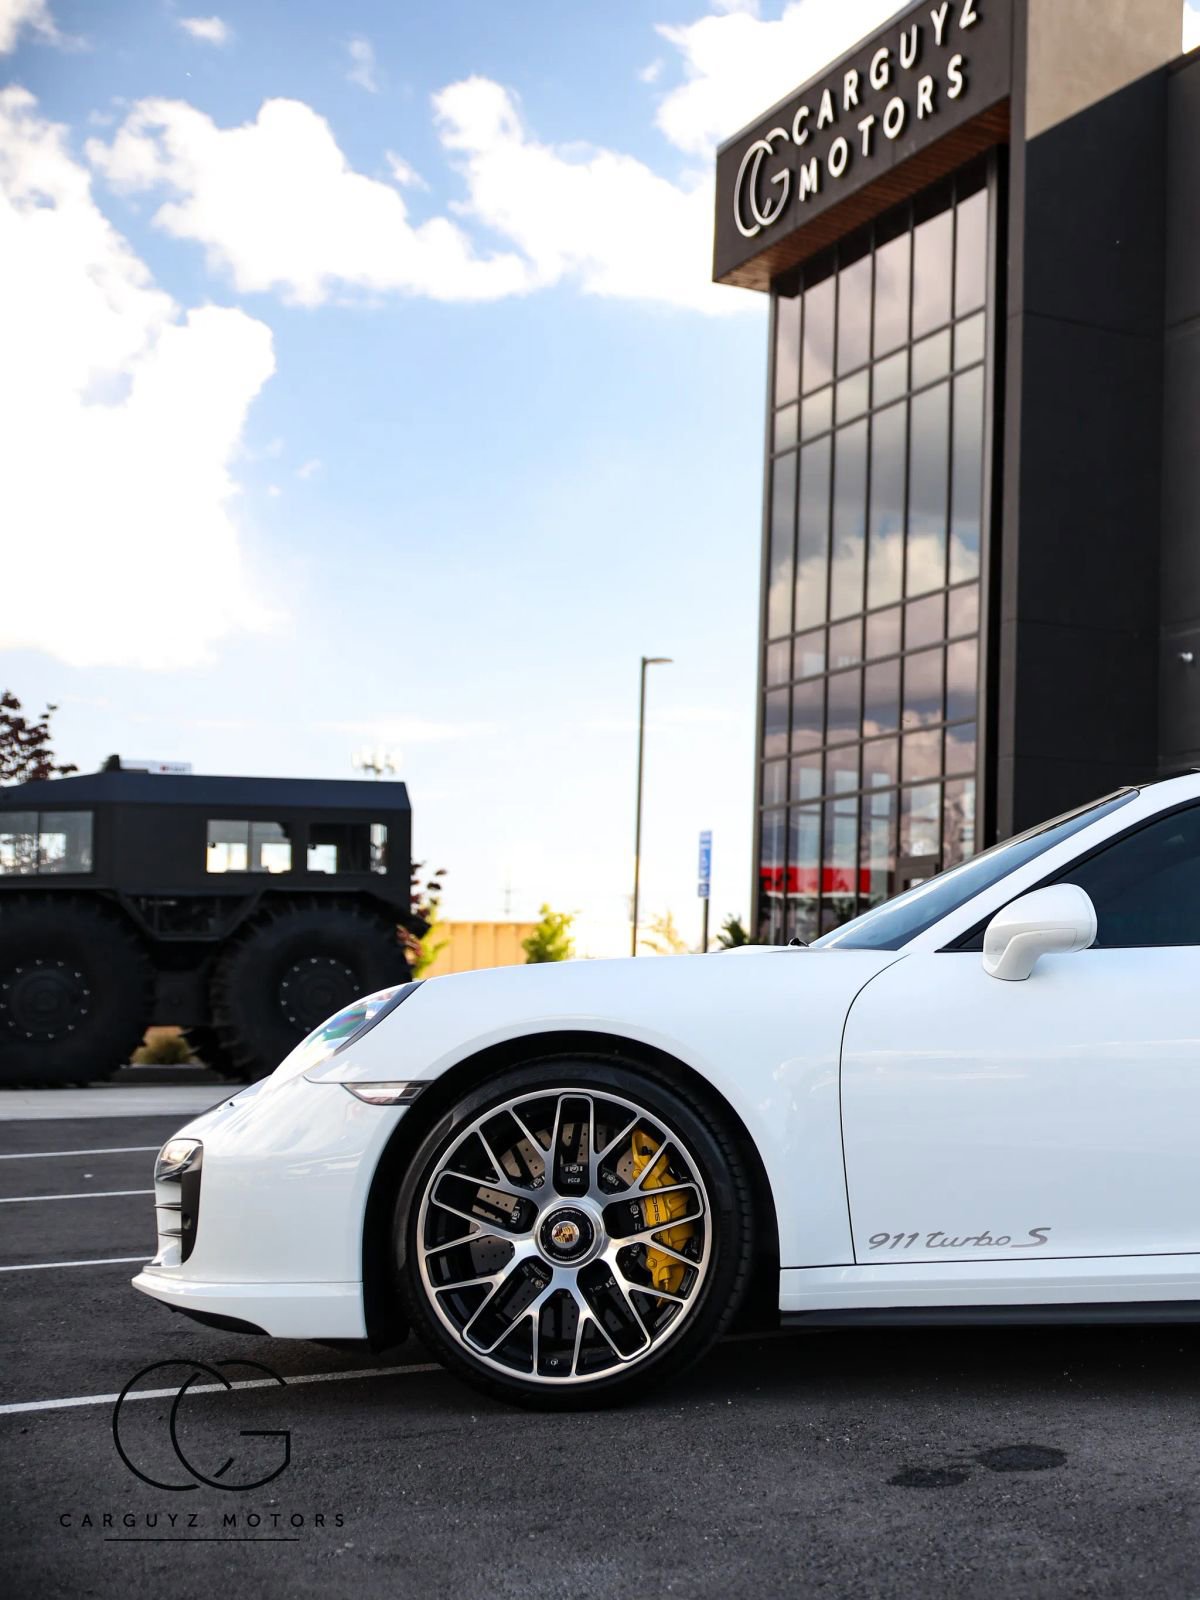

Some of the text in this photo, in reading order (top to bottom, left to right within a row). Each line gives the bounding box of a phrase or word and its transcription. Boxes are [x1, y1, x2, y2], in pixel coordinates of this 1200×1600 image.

[799, 54, 963, 202] MOTORS
[869, 1227, 1052, 1249] 911 turbo S
